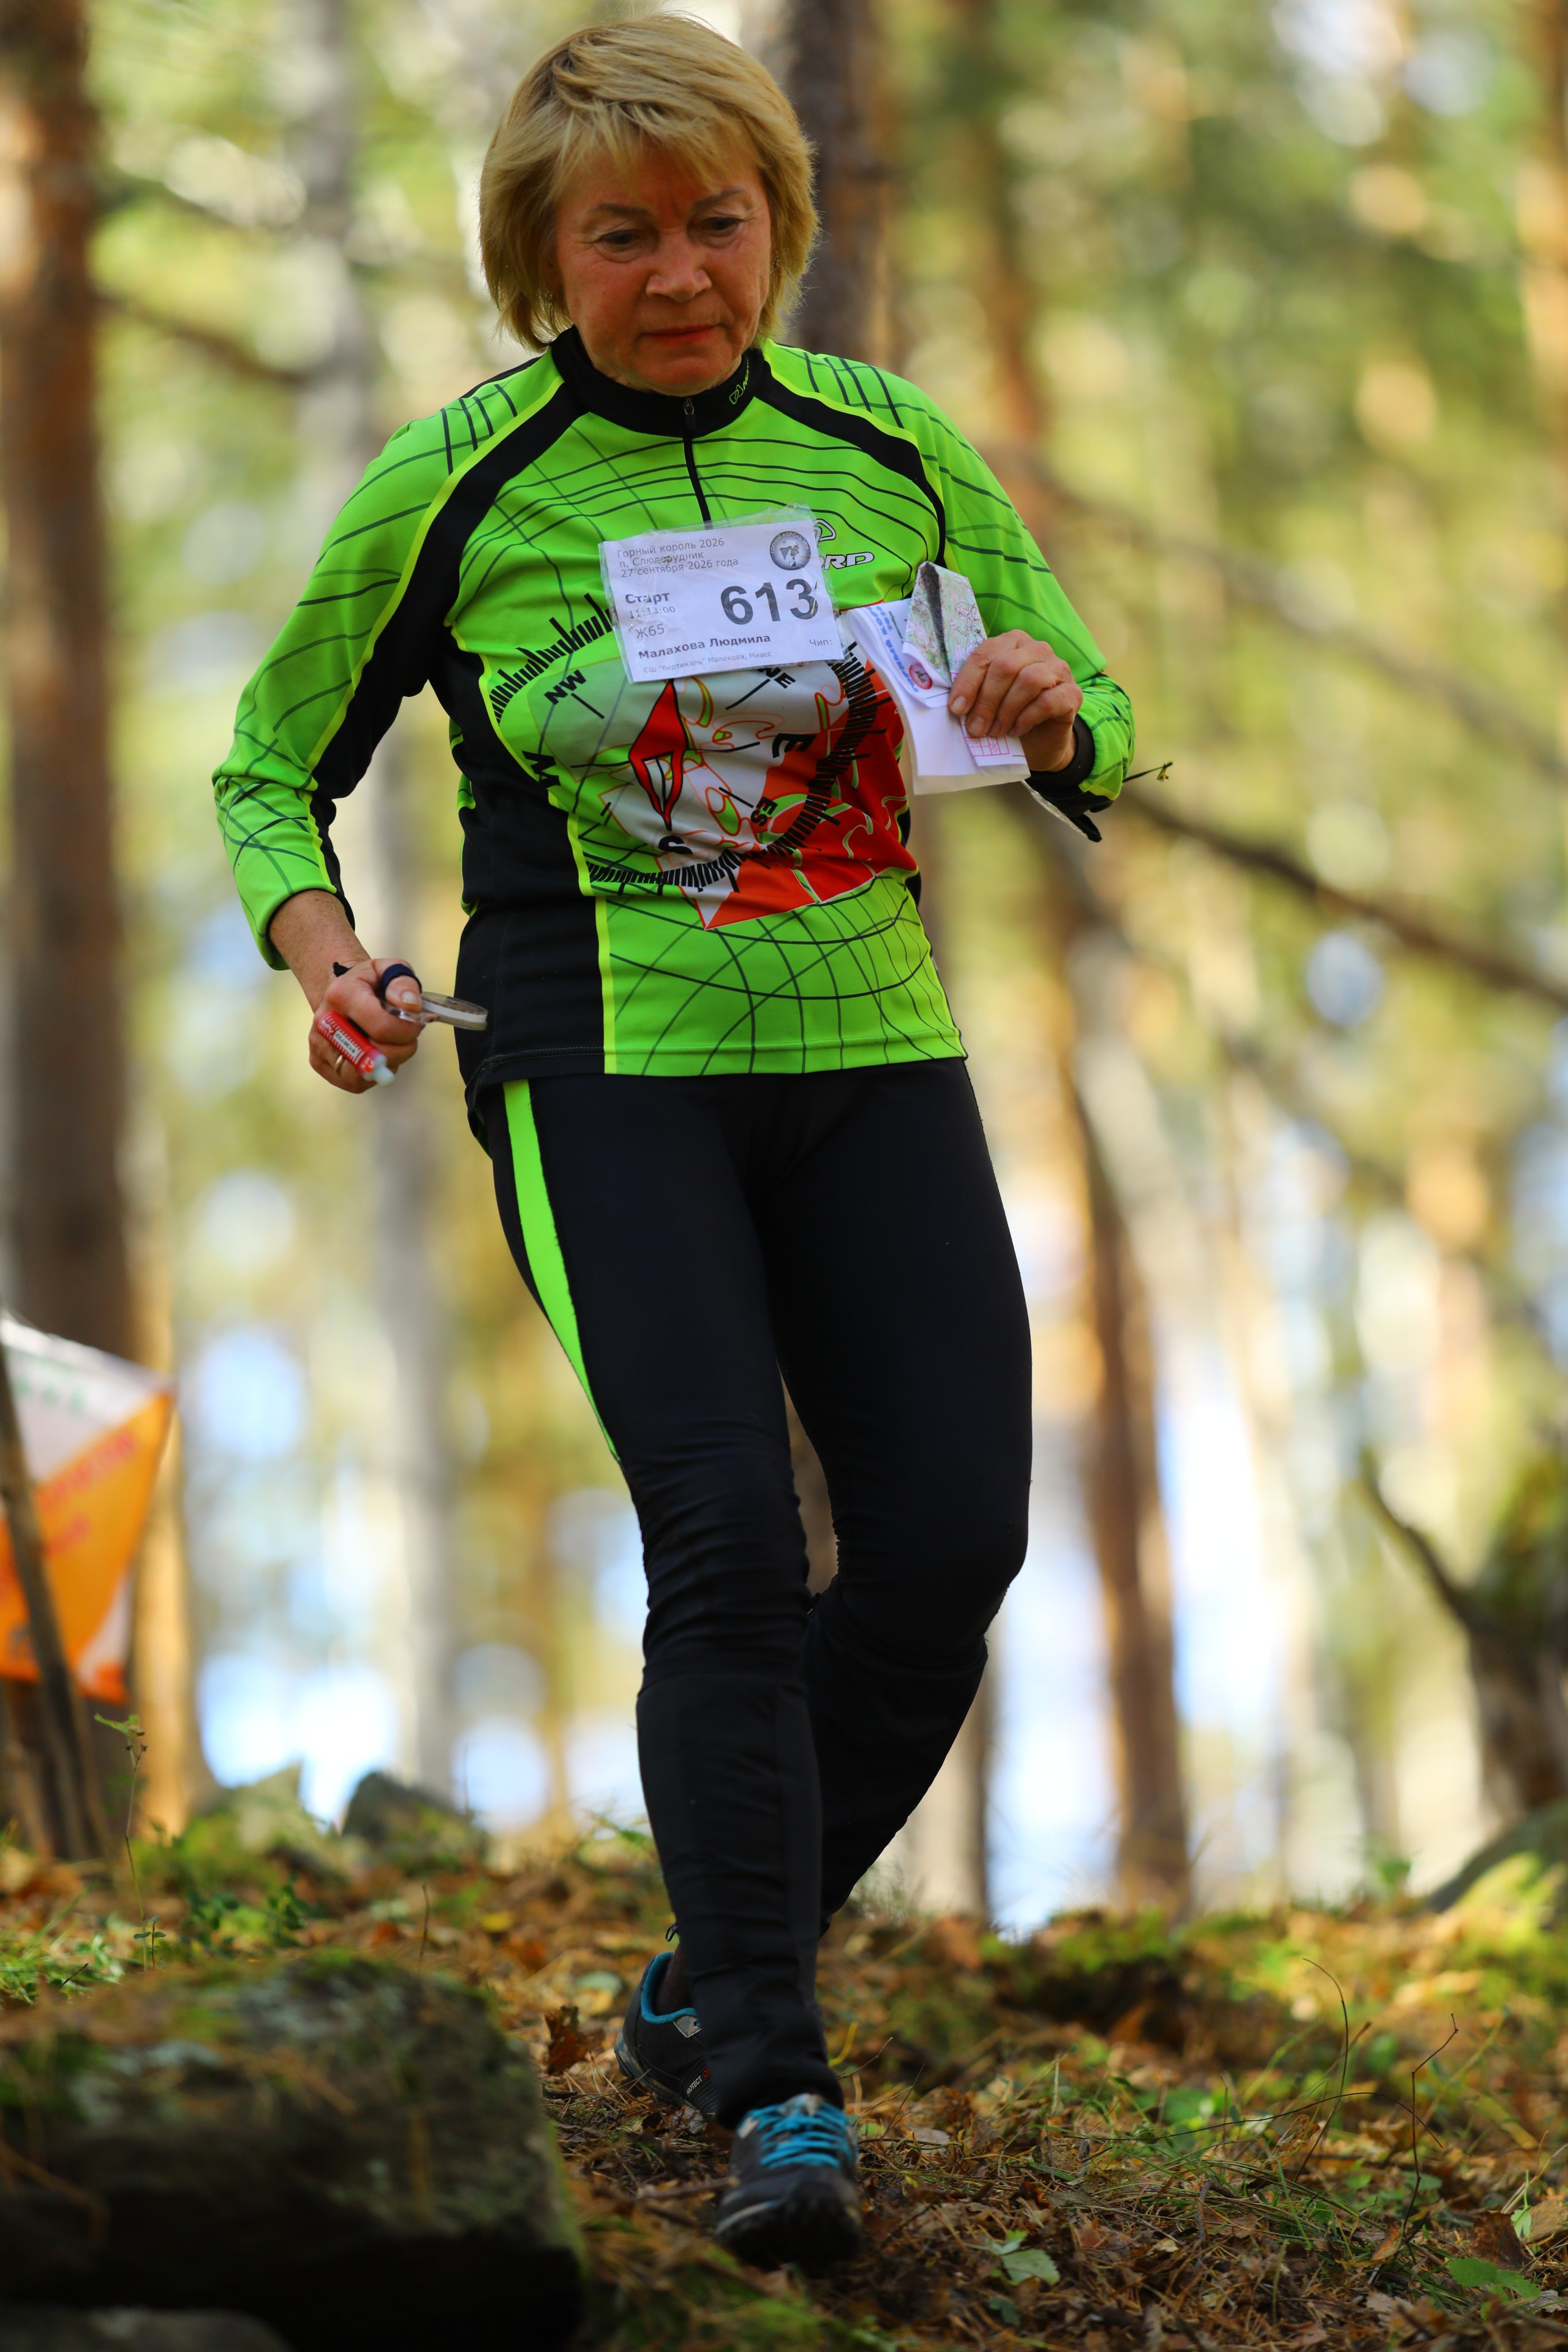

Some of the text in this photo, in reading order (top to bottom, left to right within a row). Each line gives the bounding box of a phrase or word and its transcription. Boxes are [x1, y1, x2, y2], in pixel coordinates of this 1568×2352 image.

[617, 538, 725, 558] Горный король 2026
[632, 552, 704, 567] Слюдорудник
[621, 559, 739, 578] 27 сентября 2026 года
[625, 592, 670, 605] Старт
[720, 578, 819, 625] 613
[635, 624, 665, 639] Ж65
[638, 635, 771, 660] Малахова Людмила
[809, 639, 833, 647] Чип:
[707, 653, 747, 663] Малахова,
[749, 650, 772, 659] Миасс
[544, 669, 586, 705] NW
